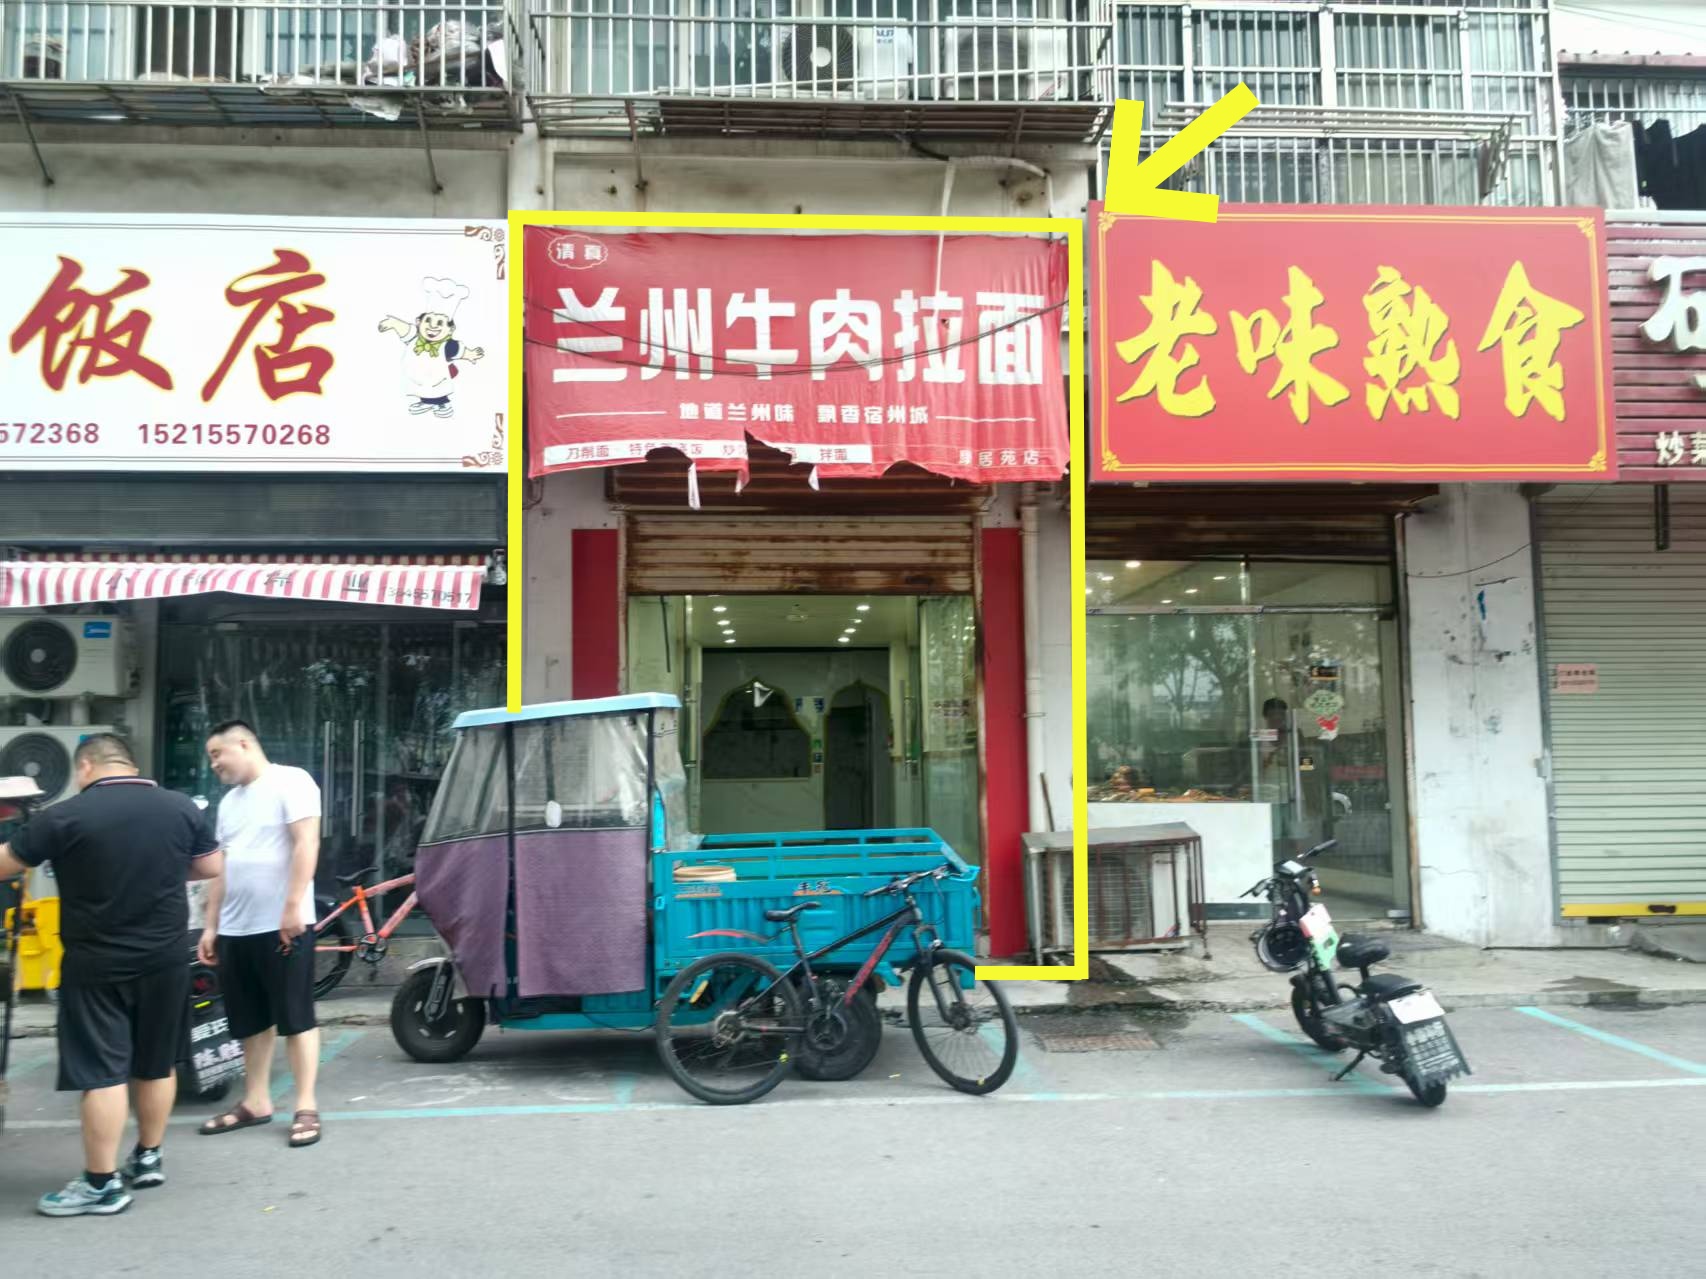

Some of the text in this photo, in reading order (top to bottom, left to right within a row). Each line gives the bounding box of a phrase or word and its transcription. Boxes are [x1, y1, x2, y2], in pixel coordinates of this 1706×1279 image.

[556, 243, 603, 260] 清真
[9, 248, 336, 402] 饭店
[1638, 255, 1706, 351] 石
[552, 286, 1045, 385] 兰州牛肉拉面
[1116, 259, 1585, 423] 老味熟食
[0, 423, 331, 446] 572368 15215570268
[679, 402, 929, 425] 地道兰州味 飘香宿州城
[566, 445, 609, 460] 刀削面
